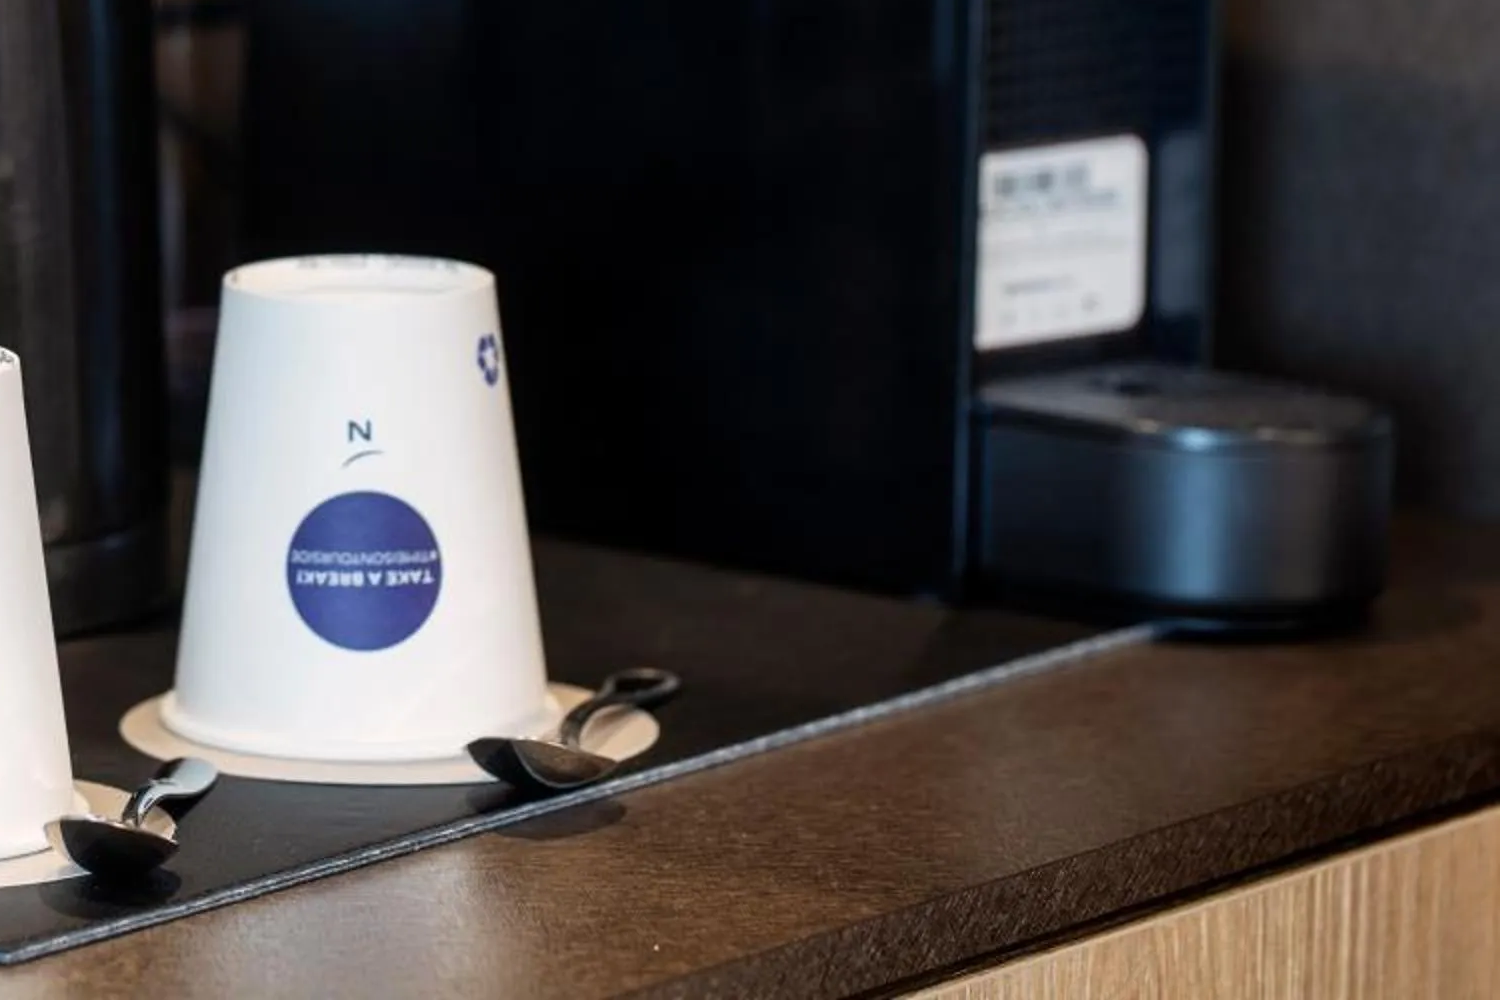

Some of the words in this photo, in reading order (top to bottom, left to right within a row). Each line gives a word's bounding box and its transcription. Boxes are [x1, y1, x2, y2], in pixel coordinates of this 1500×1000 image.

[348, 420, 372, 442] N
[296, 570, 363, 586] BREAK!
[368, 571, 382, 585] A
[387, 569, 435, 586] TAKE
